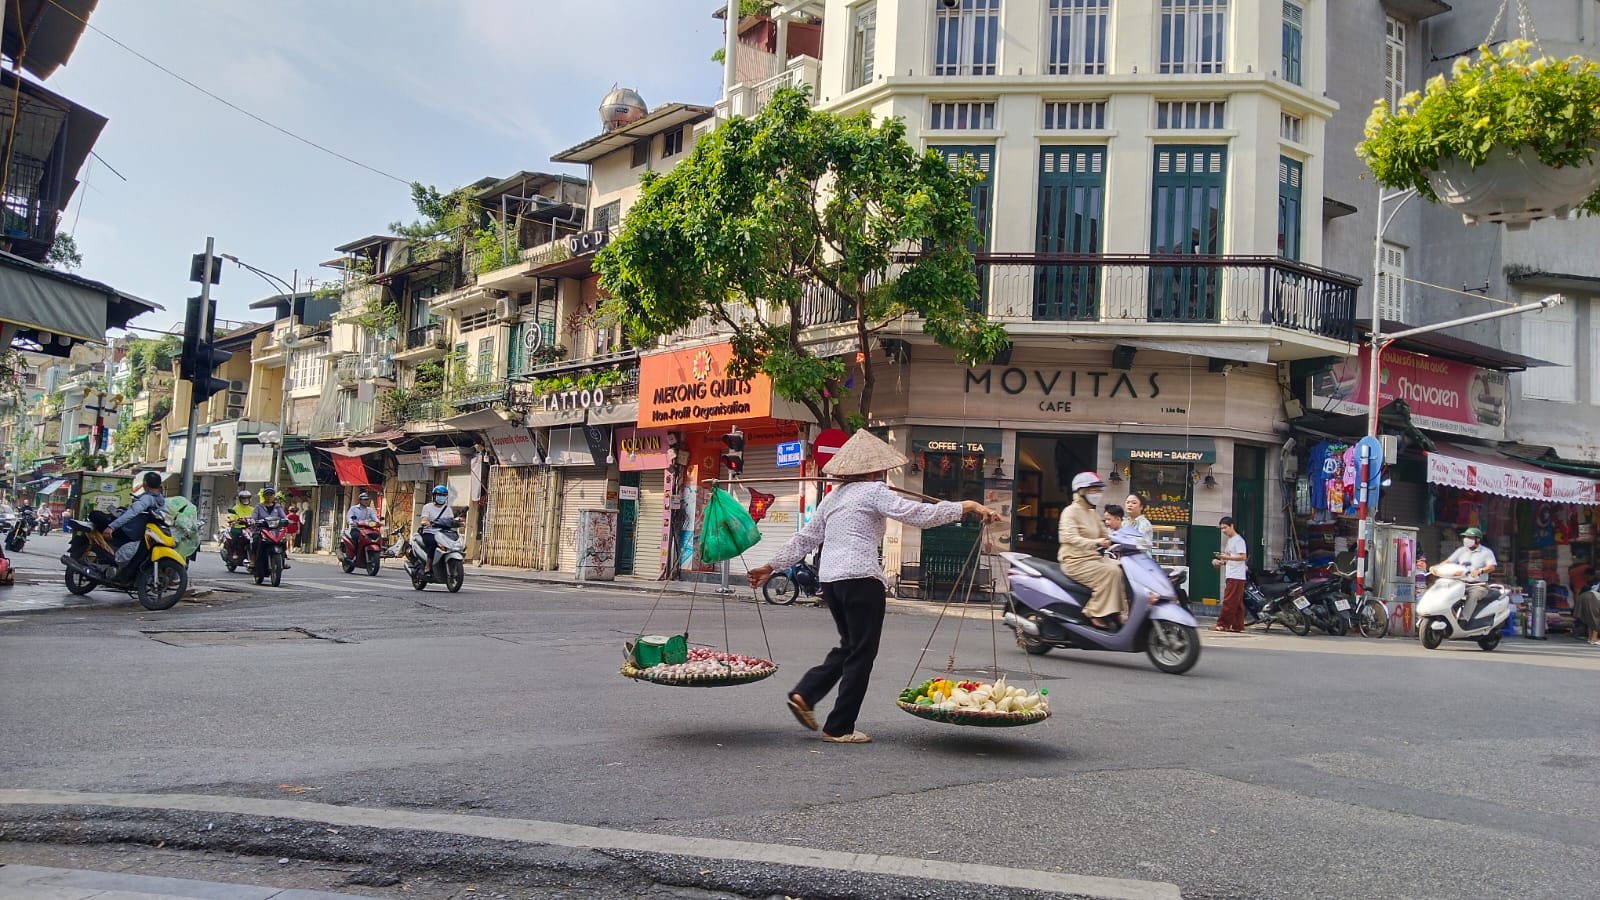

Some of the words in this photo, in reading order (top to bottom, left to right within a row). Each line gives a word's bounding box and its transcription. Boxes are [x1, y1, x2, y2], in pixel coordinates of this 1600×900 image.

[571, 231, 602, 251] OCD
[653, 381, 707, 404] MEKONG
[710, 376, 752, 398] QUILTS
[965, 367, 1160, 398] MOVITAS
[1398, 377, 1458, 408] Shavoren
[541, 388, 603, 412] TATTOO
[1039, 401, 1072, 412] CAFE
[652, 406, 691, 422] Non-Profit
[693, 402, 750, 420] Organisation
[621, 438, 644, 451] COZY
[646, 436, 660, 449] VN
[928, 441, 957, 450] COFFEE
[967, 443, 984, 452] TEA
[1130, 450, 1163, 459] BANHMI
[1171, 451, 1203, 460] BAKERY
